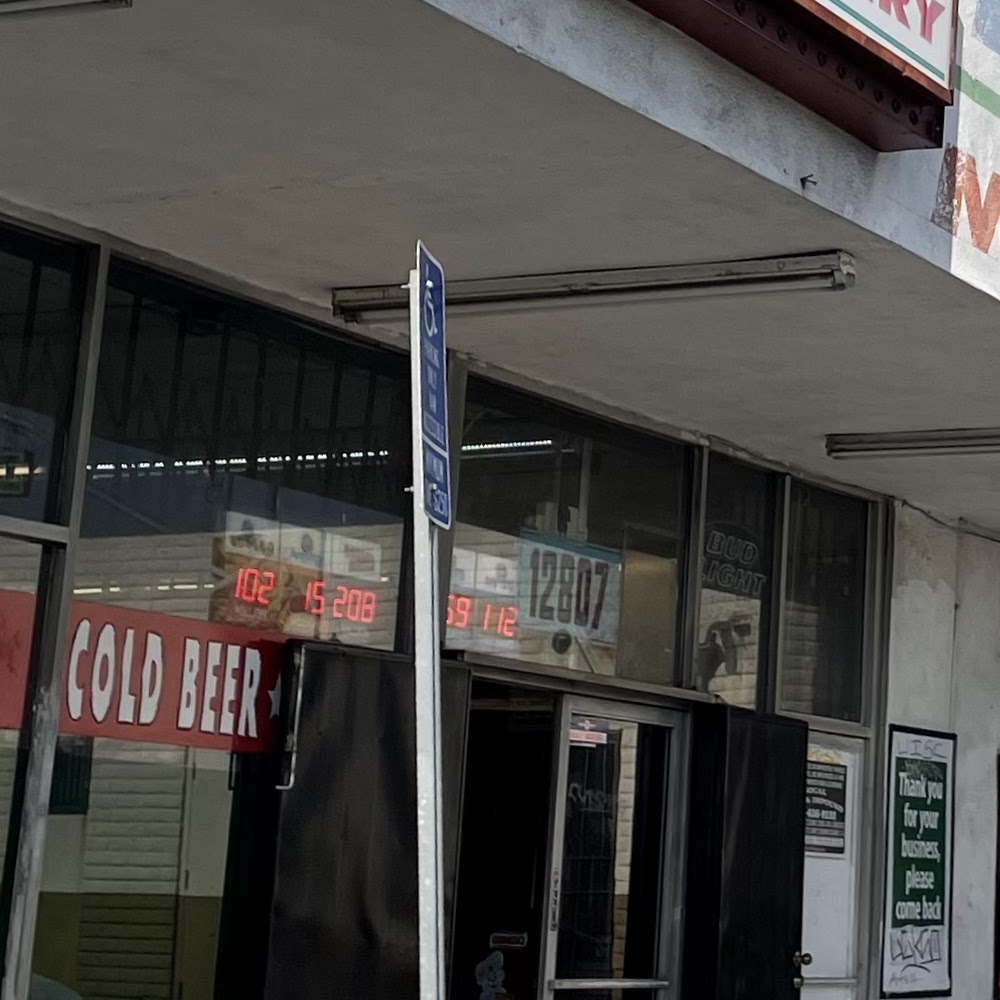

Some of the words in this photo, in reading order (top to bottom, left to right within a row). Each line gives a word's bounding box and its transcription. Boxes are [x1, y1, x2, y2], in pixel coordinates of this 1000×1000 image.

[706, 530, 759, 565] BUD
[234, 566, 276, 606] 102
[530, 547, 609, 630] 12807
[66, 618, 164, 726] COLD
[177, 636, 262, 739] BEER
[898, 771, 927, 799] Thank
[926, 781, 944, 805] you
[903, 802, 918, 828] for
[916, 810, 940, 839] your
[901, 832, 942, 864] business,
[905, 864, 935, 895] please
[895, 898, 921, 920] come
[922, 895, 943, 920] back
